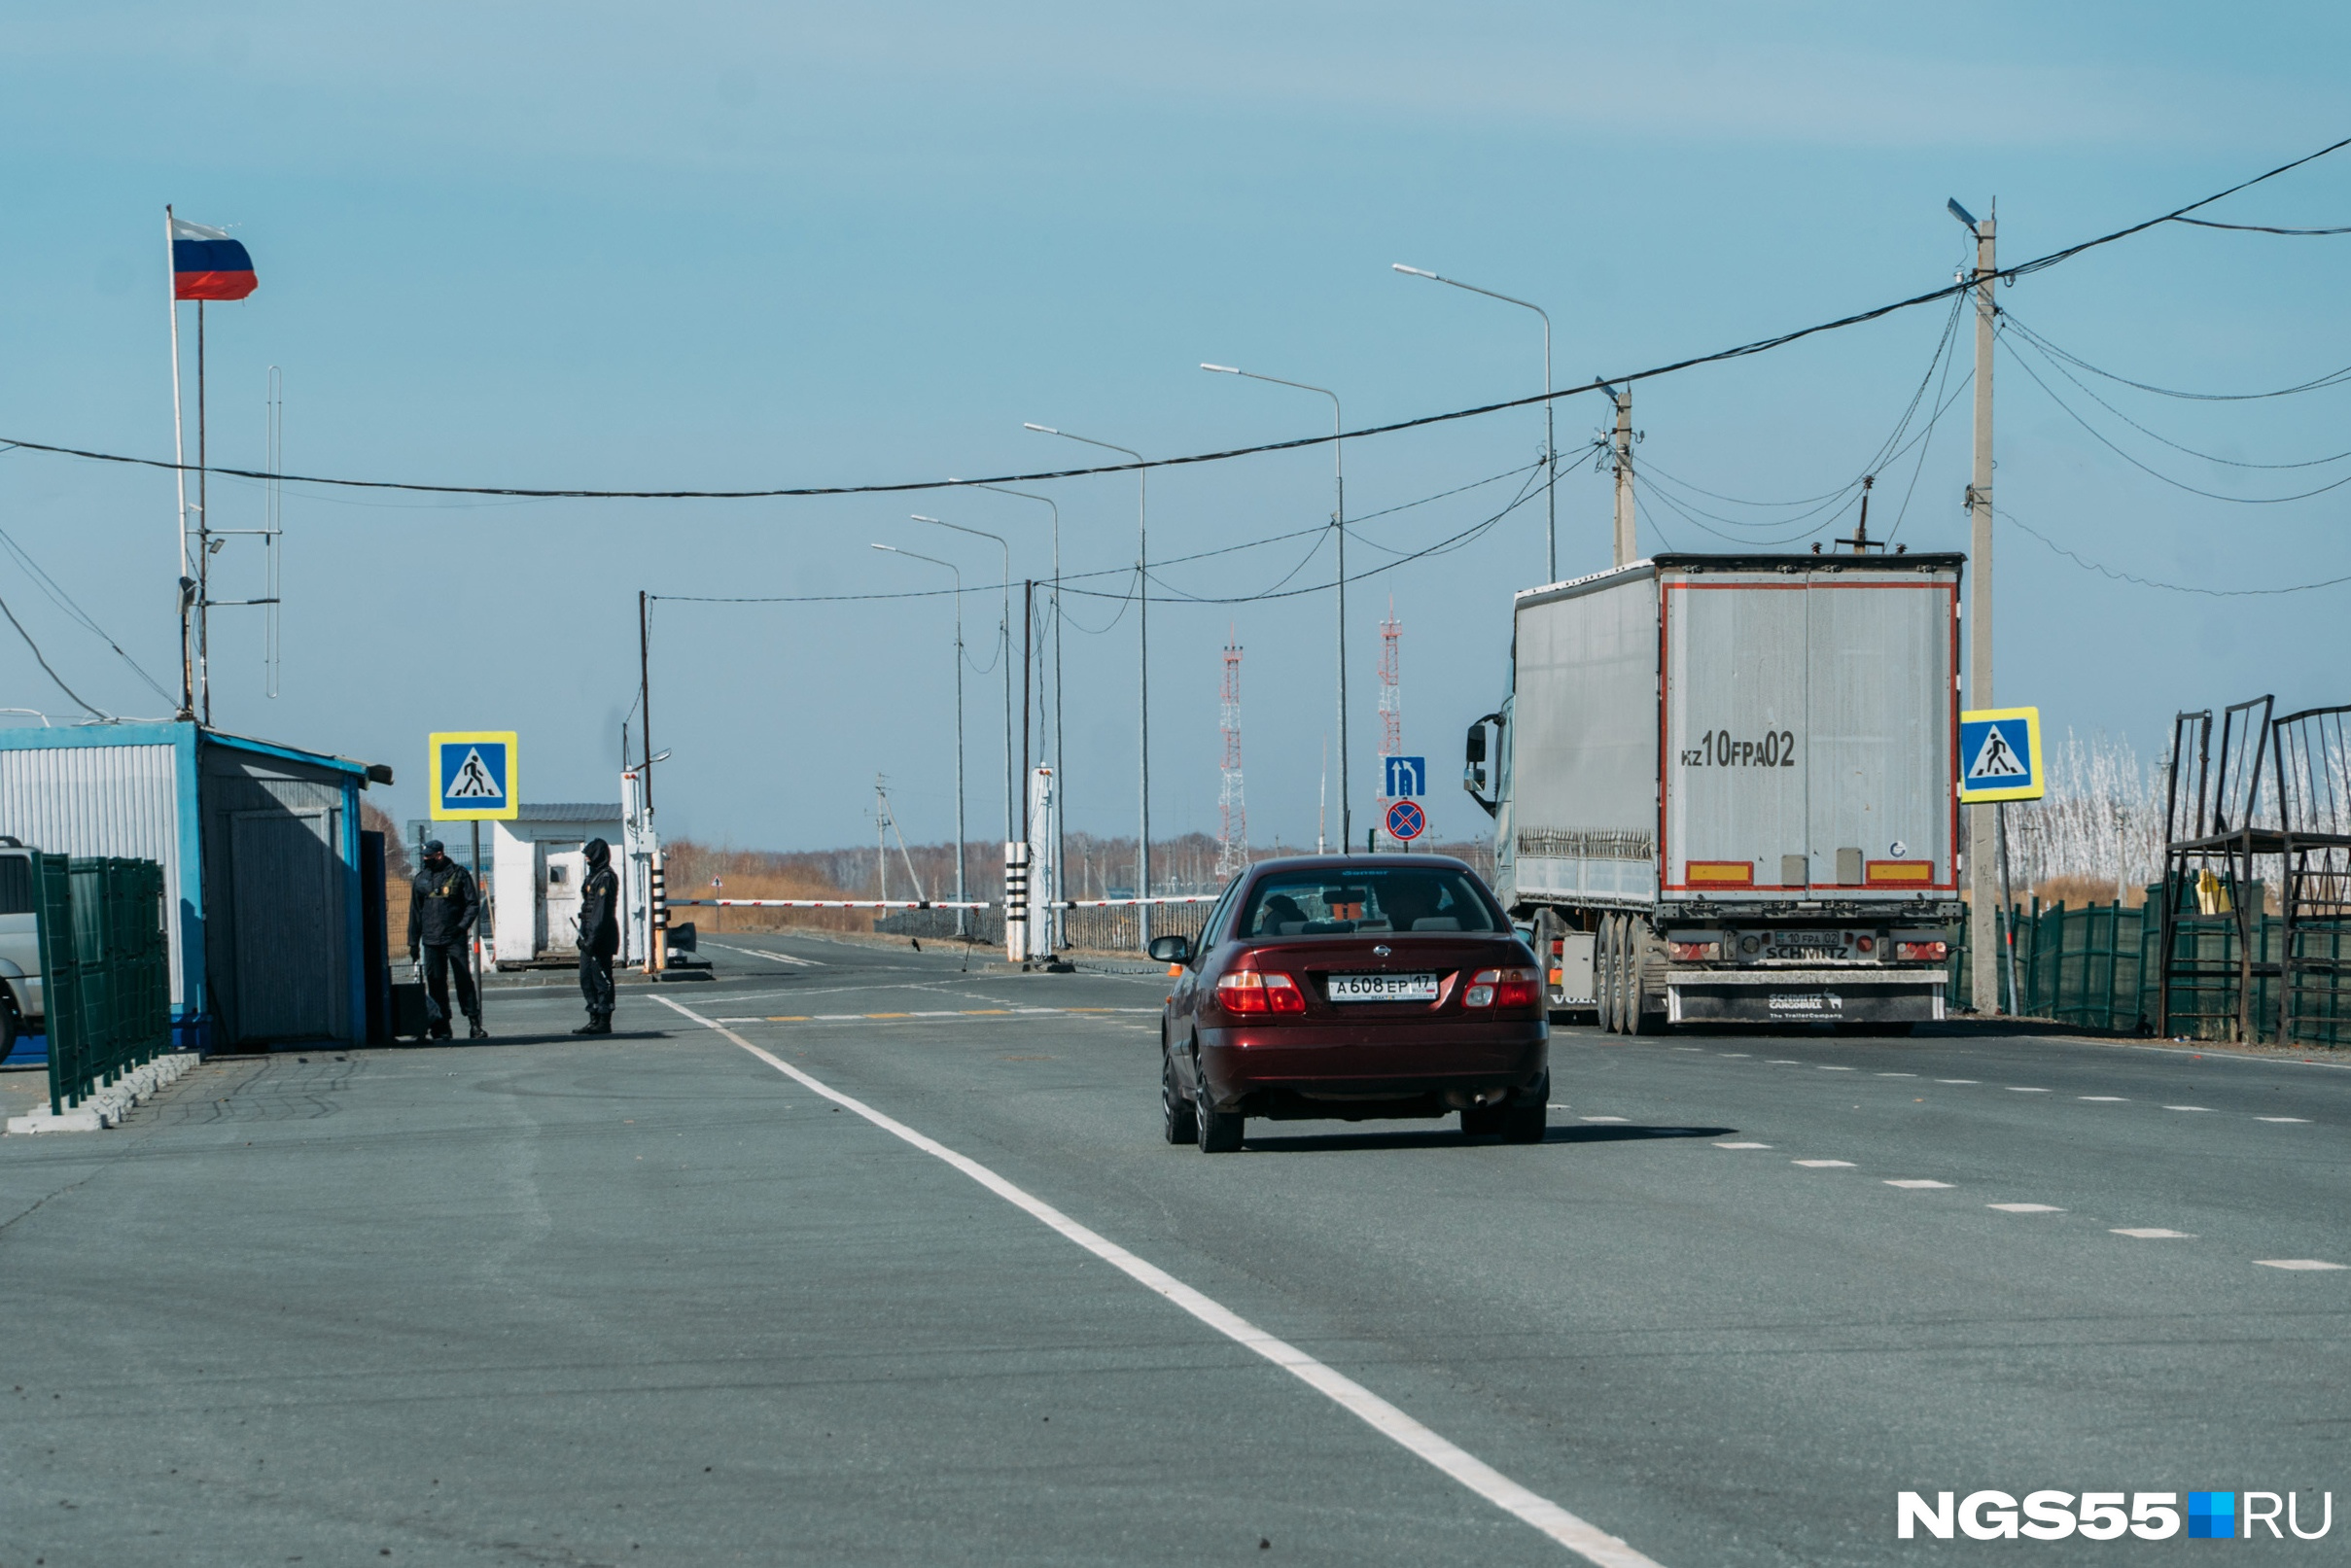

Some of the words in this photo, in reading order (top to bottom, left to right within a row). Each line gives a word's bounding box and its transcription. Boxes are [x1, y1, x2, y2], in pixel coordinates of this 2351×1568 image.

[1788, 933, 1800, 943] 10
[1802, 935, 1820, 944] FPA
[1824, 933, 1837, 944] 02
[1766, 947, 1848, 959] SCHMITZ
[1413, 975, 1430, 988] 17
[1769, 993, 1822, 1002] SCHMITZ
